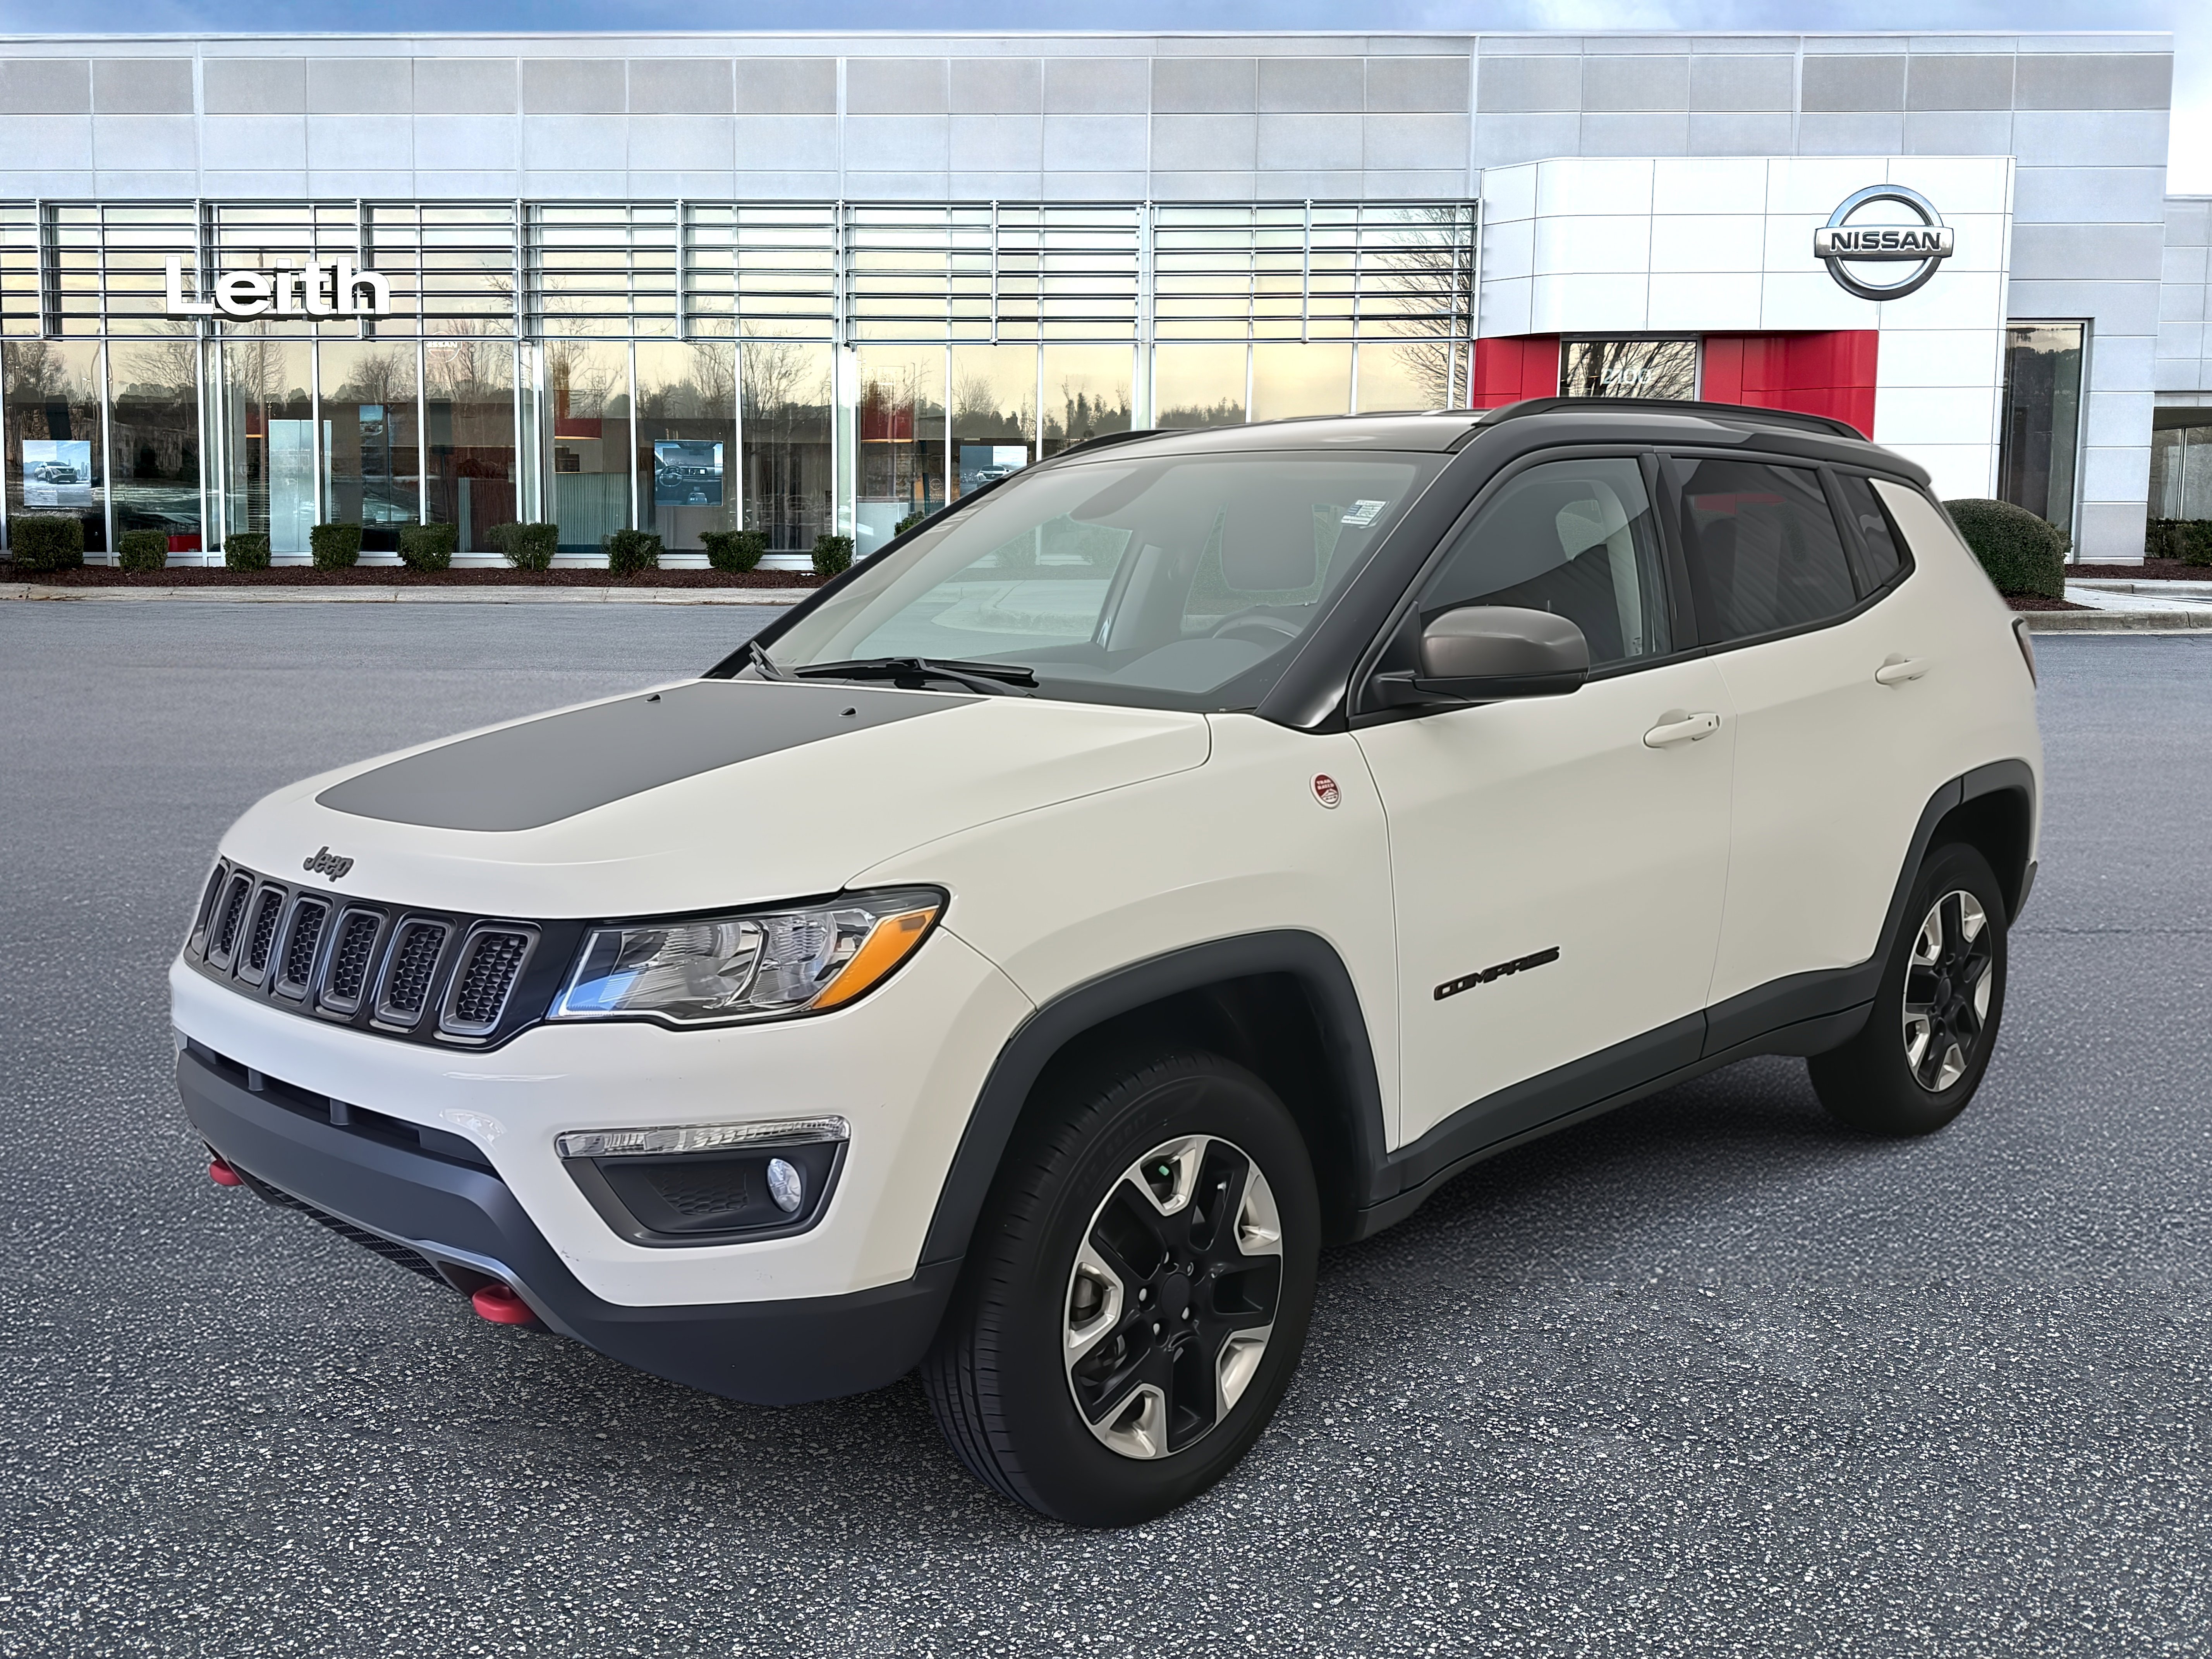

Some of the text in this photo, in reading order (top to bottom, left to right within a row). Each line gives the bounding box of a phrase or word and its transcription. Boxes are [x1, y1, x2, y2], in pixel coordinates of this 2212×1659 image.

[1831, 231, 1941, 251] NISSAN
[165, 256, 390, 316] Leith
[303, 846, 354, 883] Jeep
